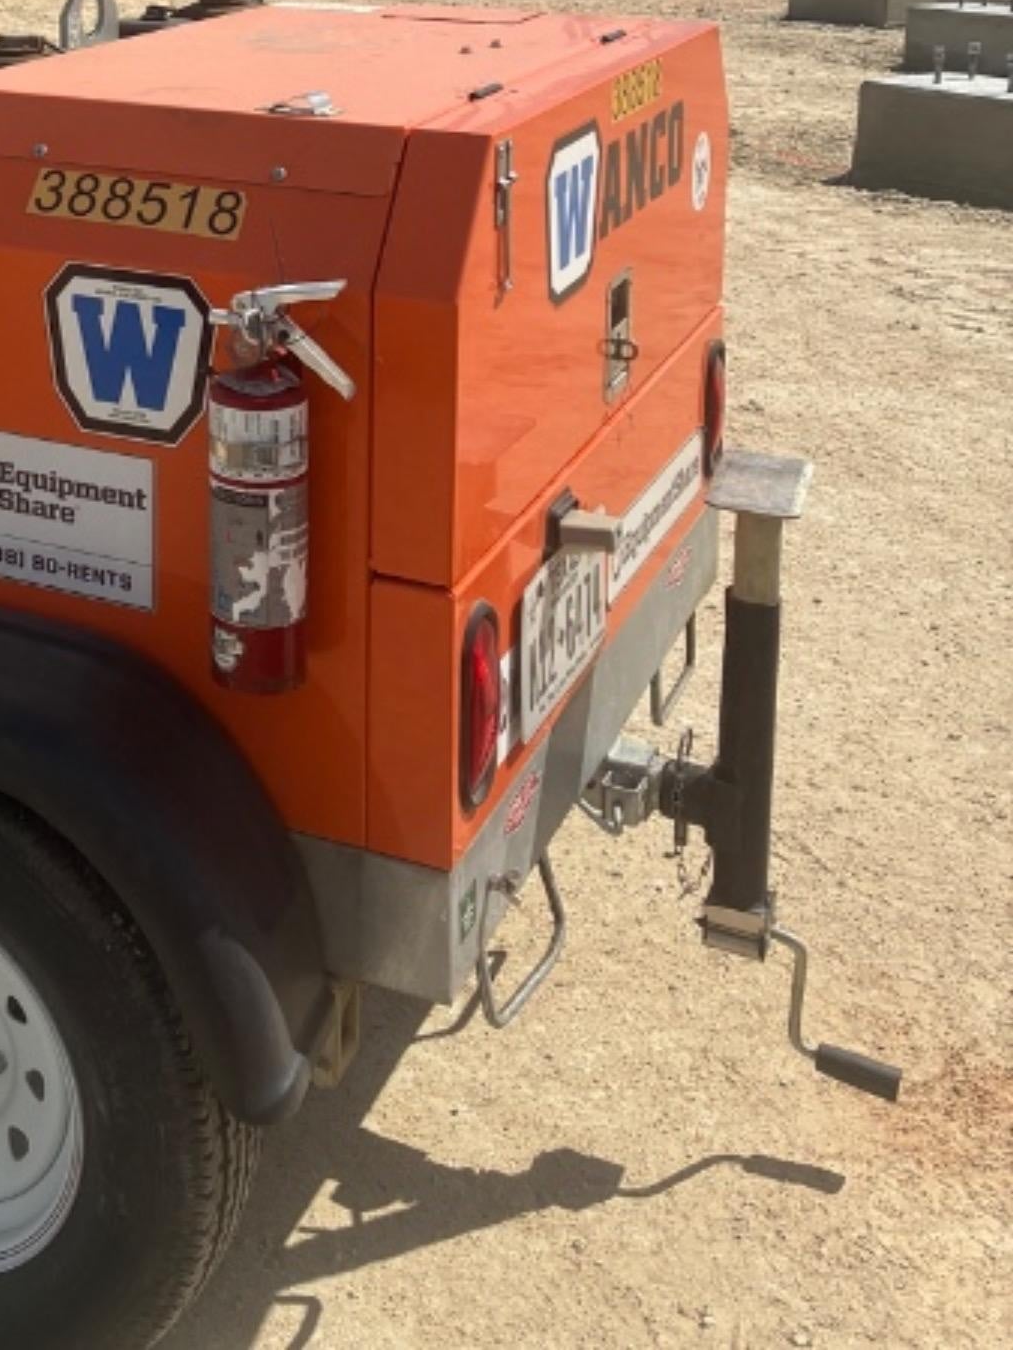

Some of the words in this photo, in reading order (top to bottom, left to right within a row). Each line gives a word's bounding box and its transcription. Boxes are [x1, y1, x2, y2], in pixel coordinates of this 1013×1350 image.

[34, 169, 243, 235] 388518
[71, 293, 186, 411] W
[31, 554, 133, 592] 80-RENTS
